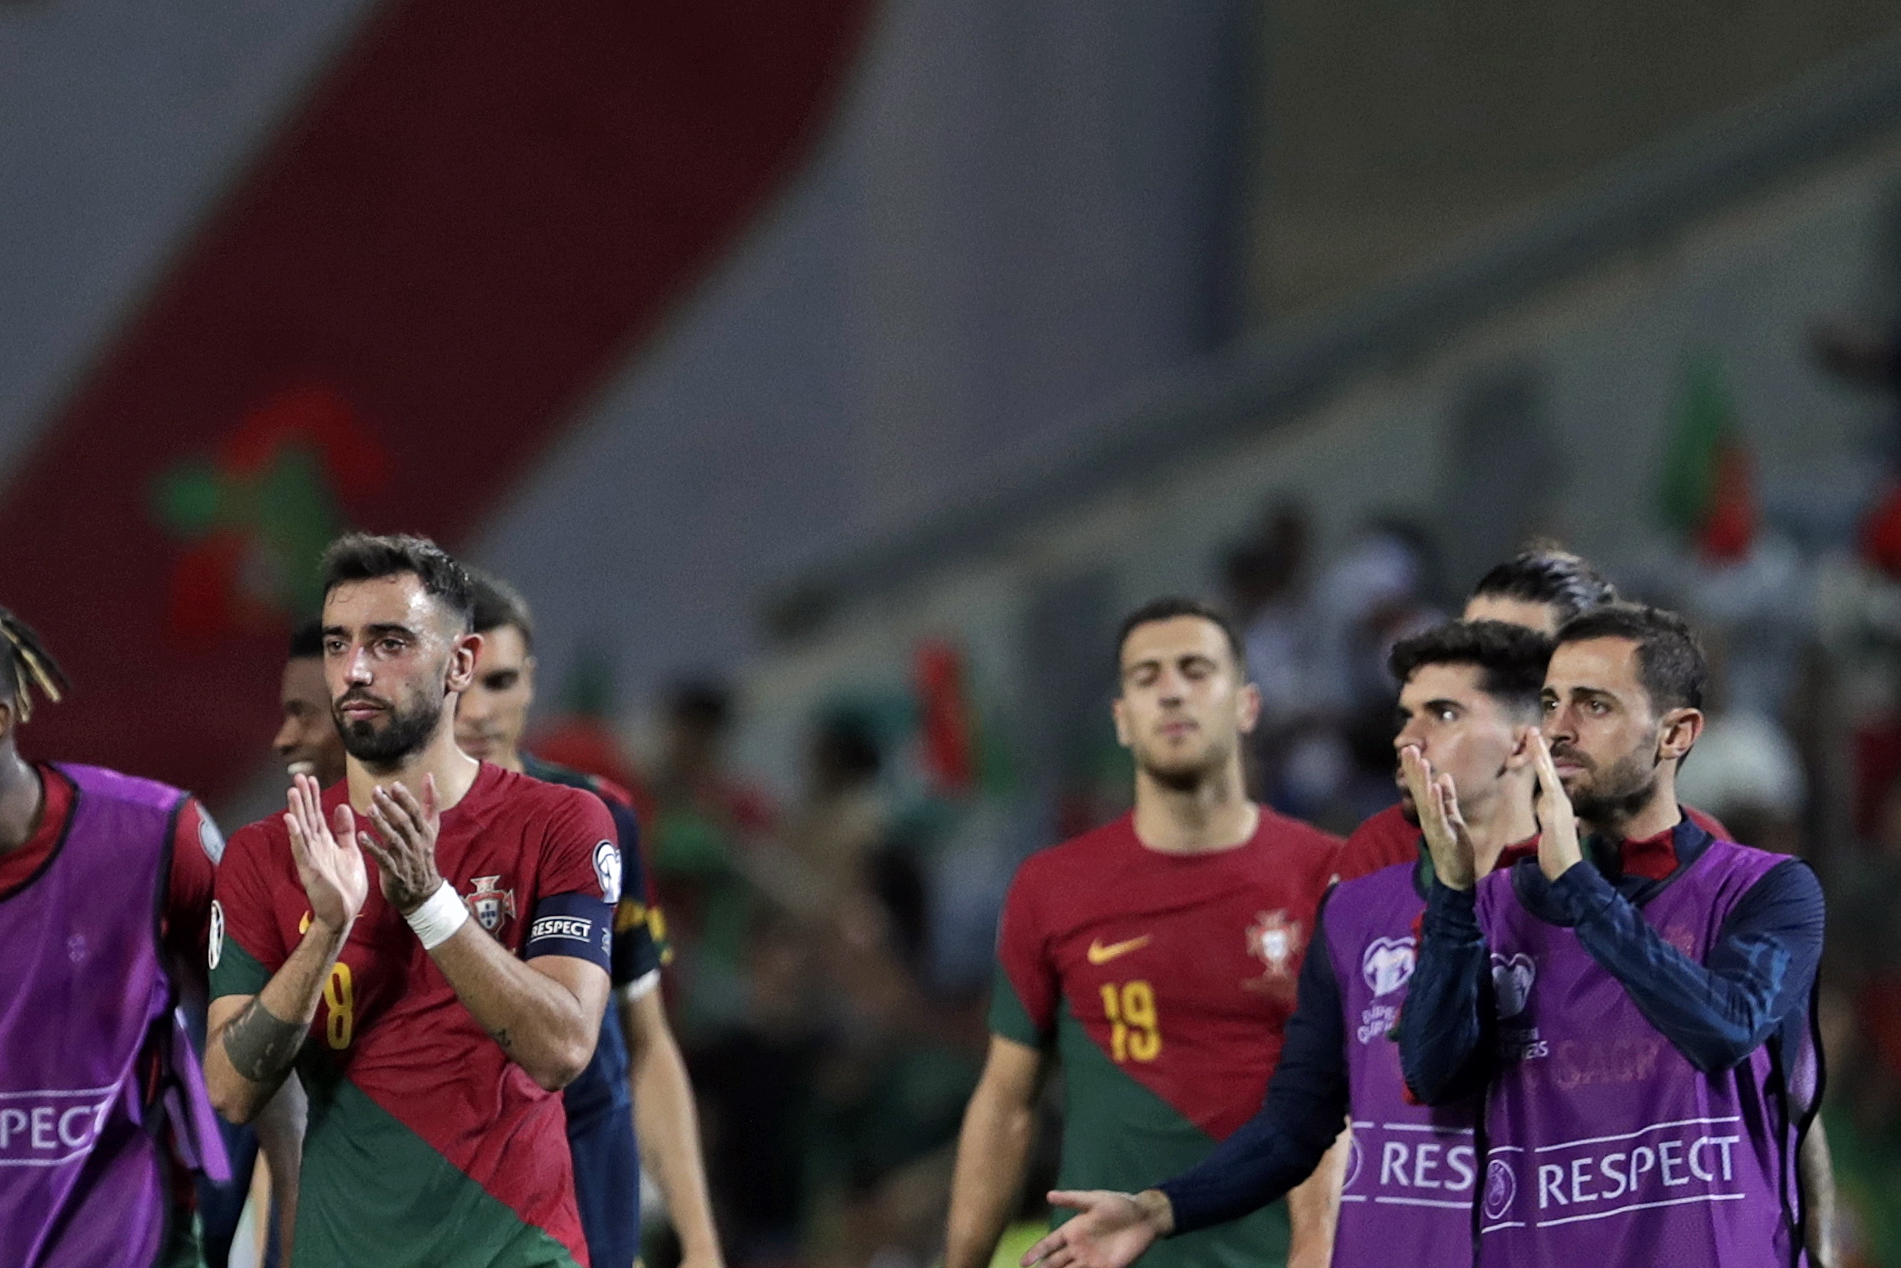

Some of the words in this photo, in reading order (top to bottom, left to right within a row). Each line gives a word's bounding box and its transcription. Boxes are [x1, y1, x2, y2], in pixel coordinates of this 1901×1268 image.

[531, 920, 591, 939] RESPECT
[323, 961, 354, 1051] 8
[1099, 980, 1161, 1065] 19
[1538, 1135, 1740, 1209] RESPECT
